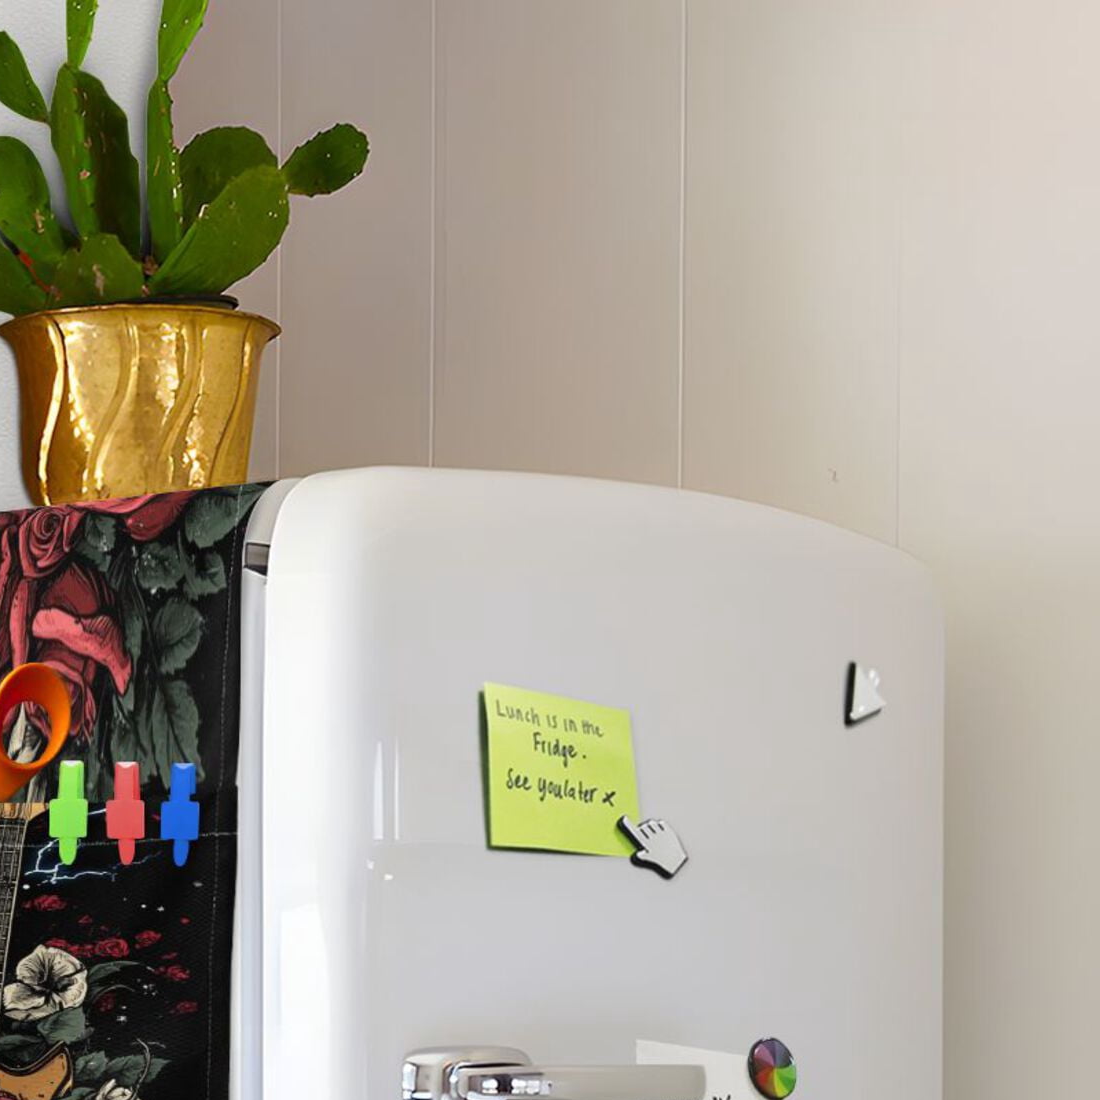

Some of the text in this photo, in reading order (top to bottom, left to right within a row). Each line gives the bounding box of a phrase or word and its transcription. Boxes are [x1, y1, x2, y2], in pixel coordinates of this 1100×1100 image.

[495, 699, 604, 737] Lunch is in the
[505, 768, 532, 791] See
